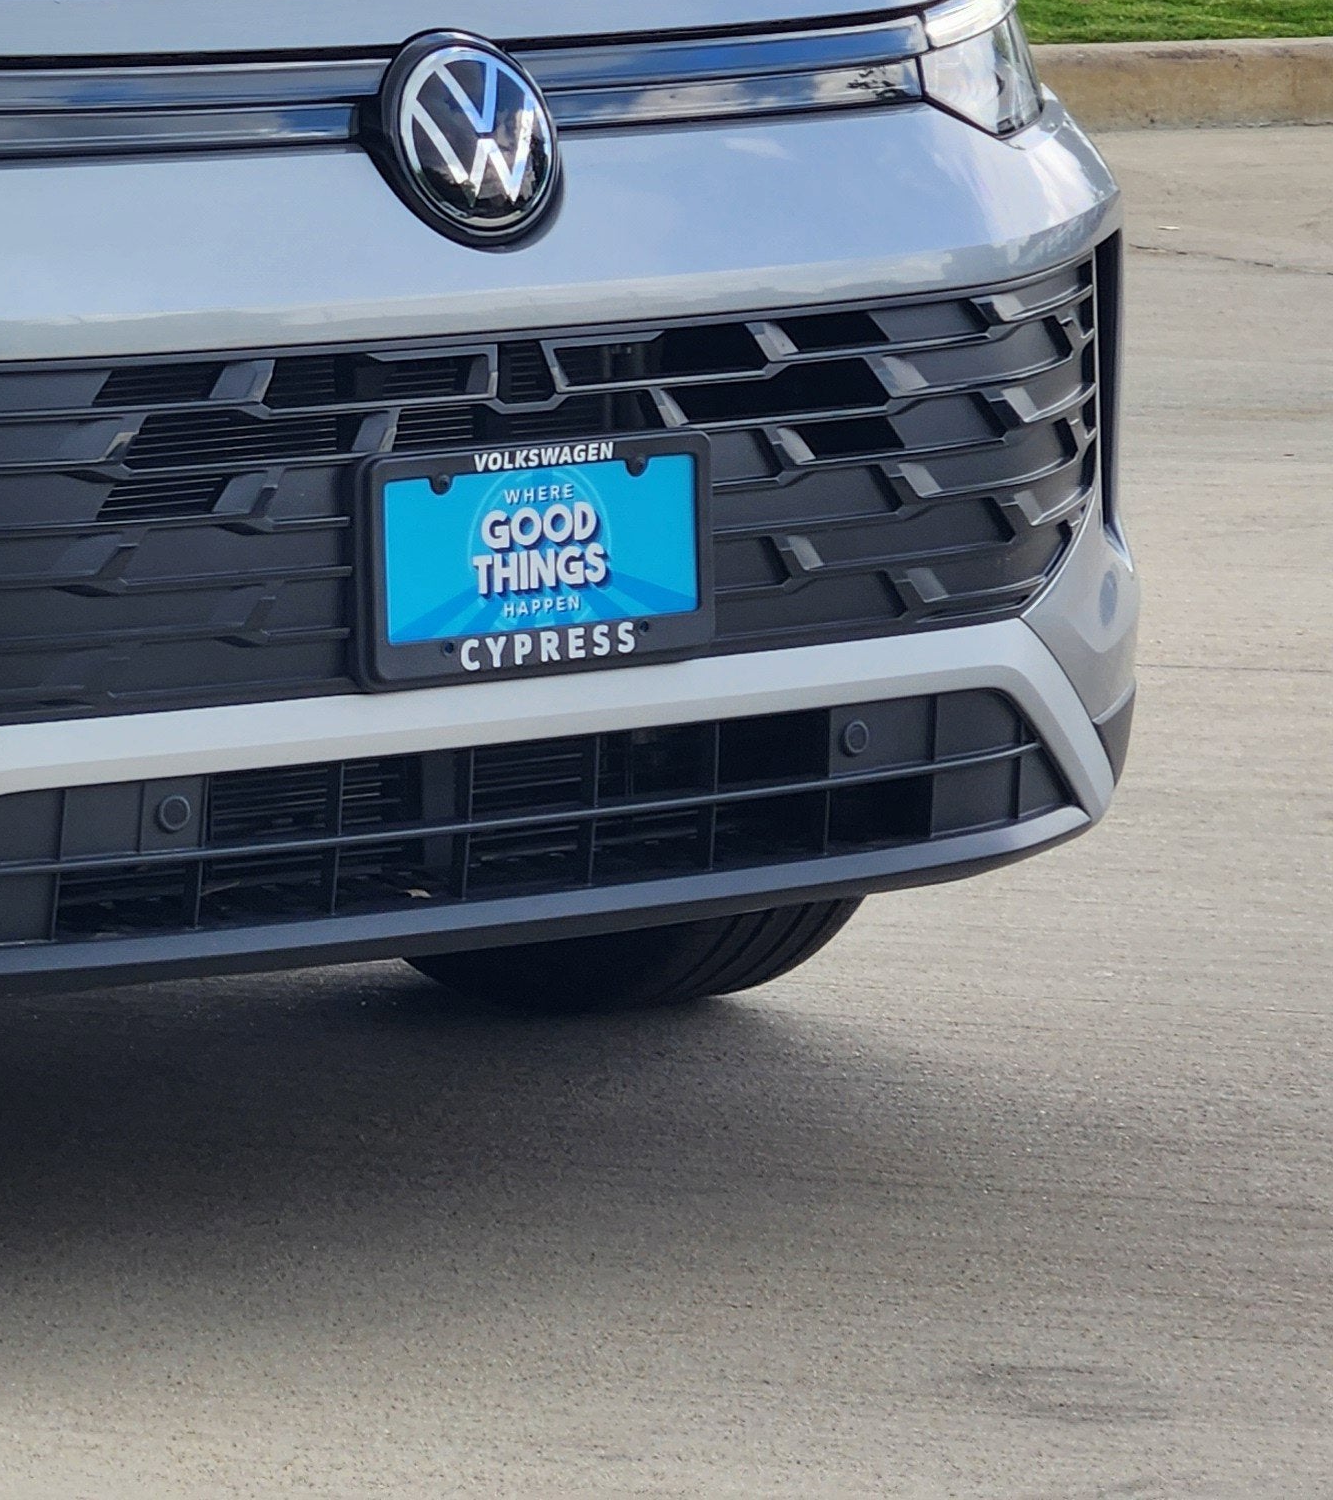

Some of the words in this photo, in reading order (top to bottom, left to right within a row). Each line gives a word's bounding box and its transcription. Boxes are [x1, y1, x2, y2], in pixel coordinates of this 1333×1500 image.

[400, 47, 552, 227] VW
[473, 441, 614, 472] VOLKSWAGEN
[504, 484, 574, 504] WHERE
[481, 501, 597, 550] GOOD
[472, 542, 607, 595] THINGS
[504, 595, 581, 618] HAPPEN
[460, 621, 635, 672] CYPRESS
